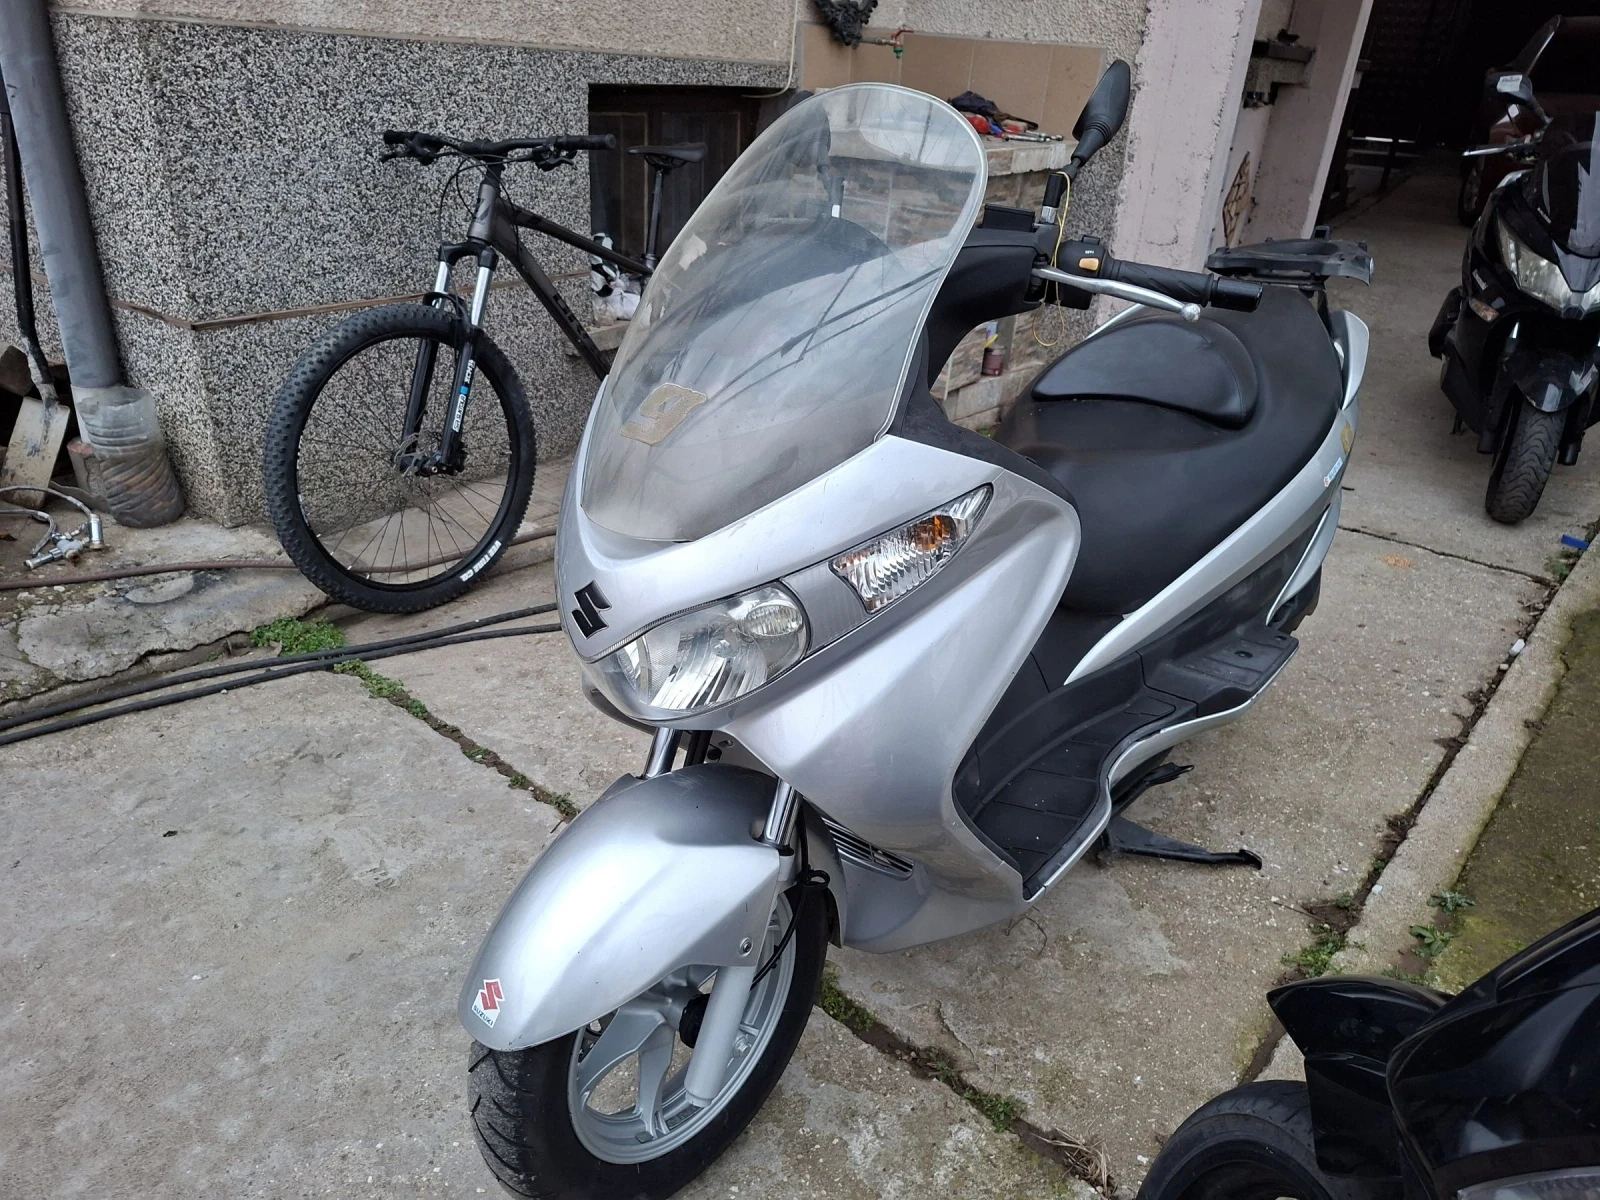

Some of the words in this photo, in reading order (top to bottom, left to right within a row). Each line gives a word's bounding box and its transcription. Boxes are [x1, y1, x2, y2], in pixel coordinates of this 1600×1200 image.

[487, 540, 502, 558] VEE
[472, 554, 491, 573] TIRE
[473, 1005, 494, 1026] SUZUKI
